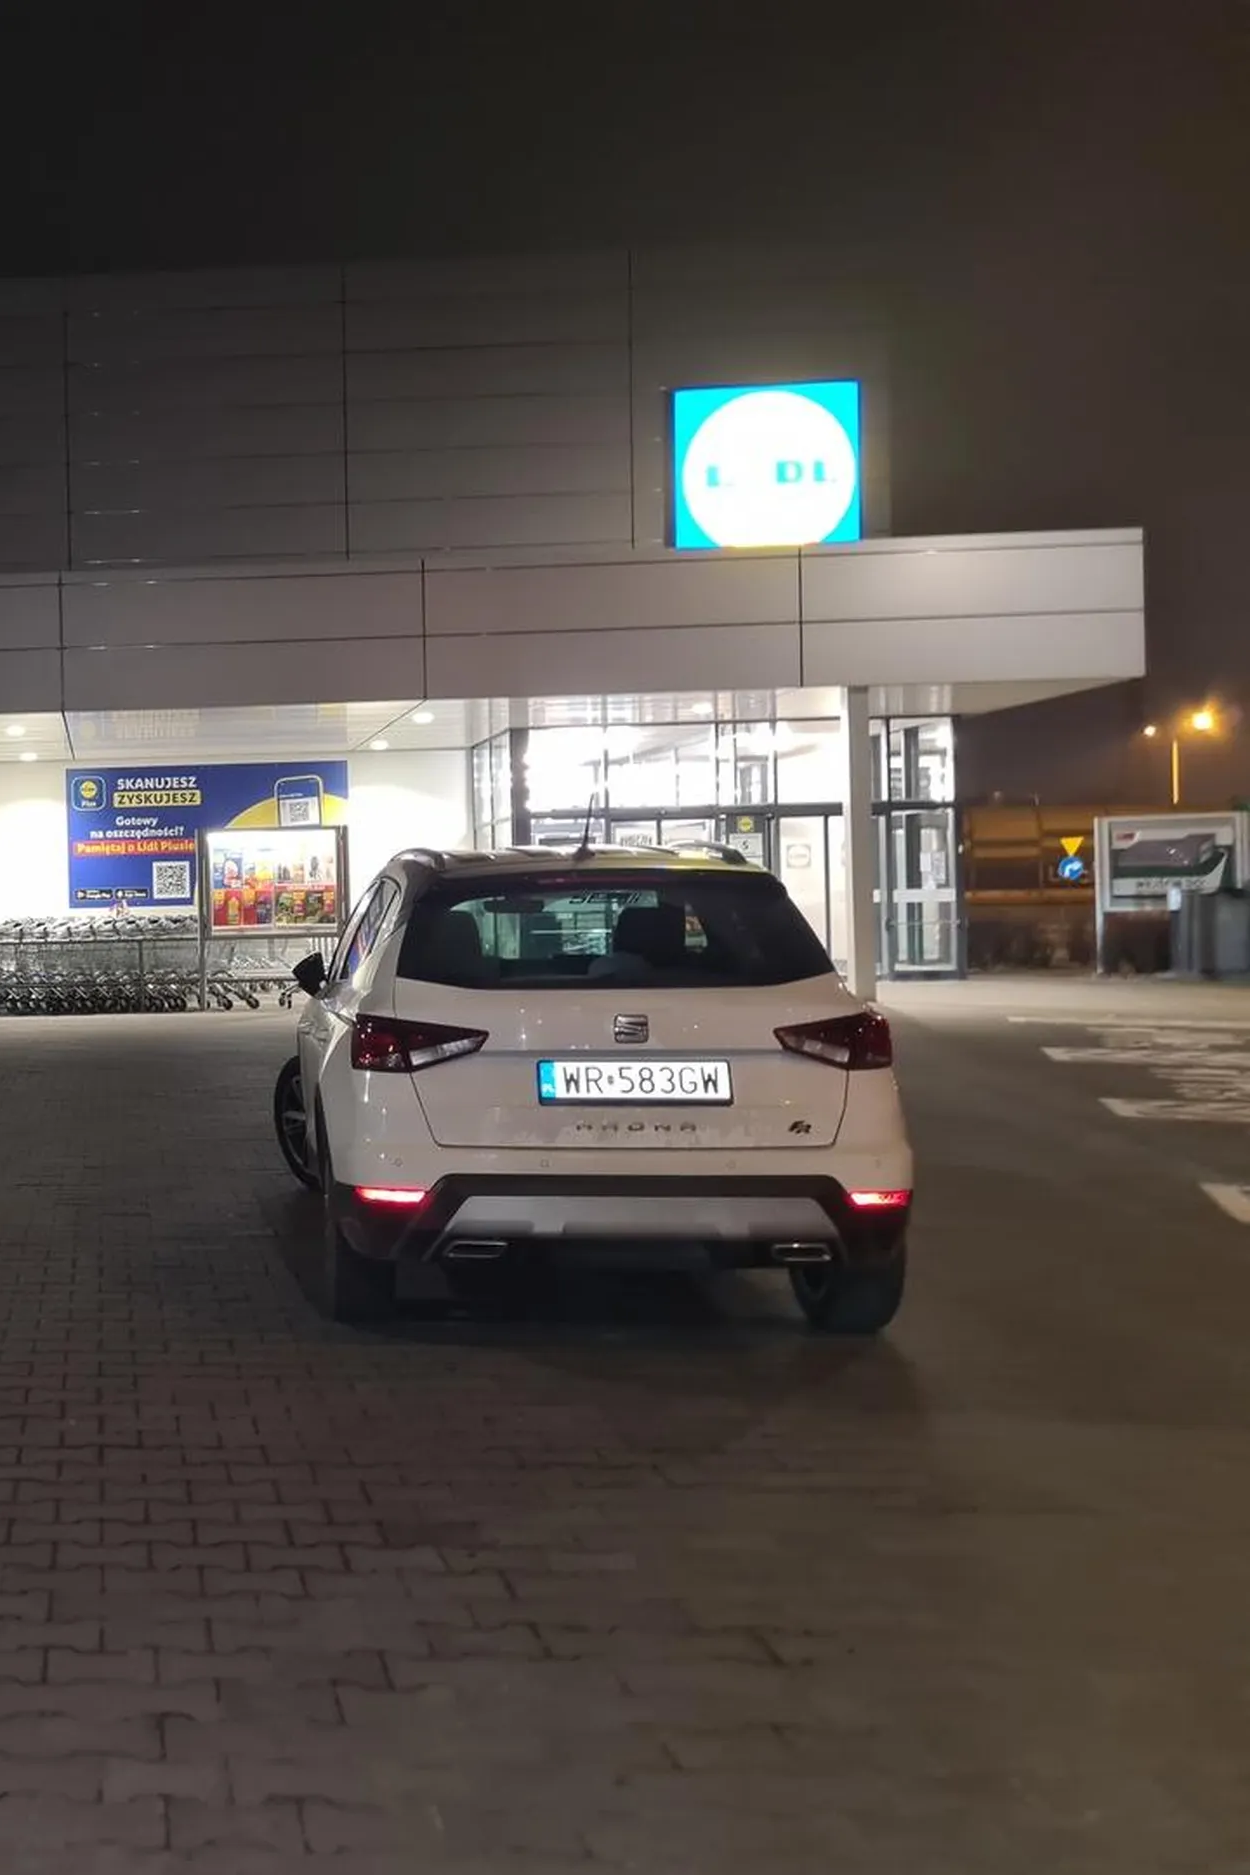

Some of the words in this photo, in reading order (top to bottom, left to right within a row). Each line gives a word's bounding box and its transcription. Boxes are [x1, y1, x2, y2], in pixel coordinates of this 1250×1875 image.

[706, 461, 838, 488] LDL
[117, 776, 197, 790] SKANUJESZ
[117, 792, 197, 805] ZYSKUJESZ
[115, 816, 158, 827] Gotowy
[90, 830, 104, 838] na
[105, 826, 184, 839] oszczędności?
[76, 842, 126, 855] Pamiętaj
[137, 840, 159, 852] Lidl
[563, 1066, 603, 1094] WR
[618, 1066, 719, 1094] 583GW
